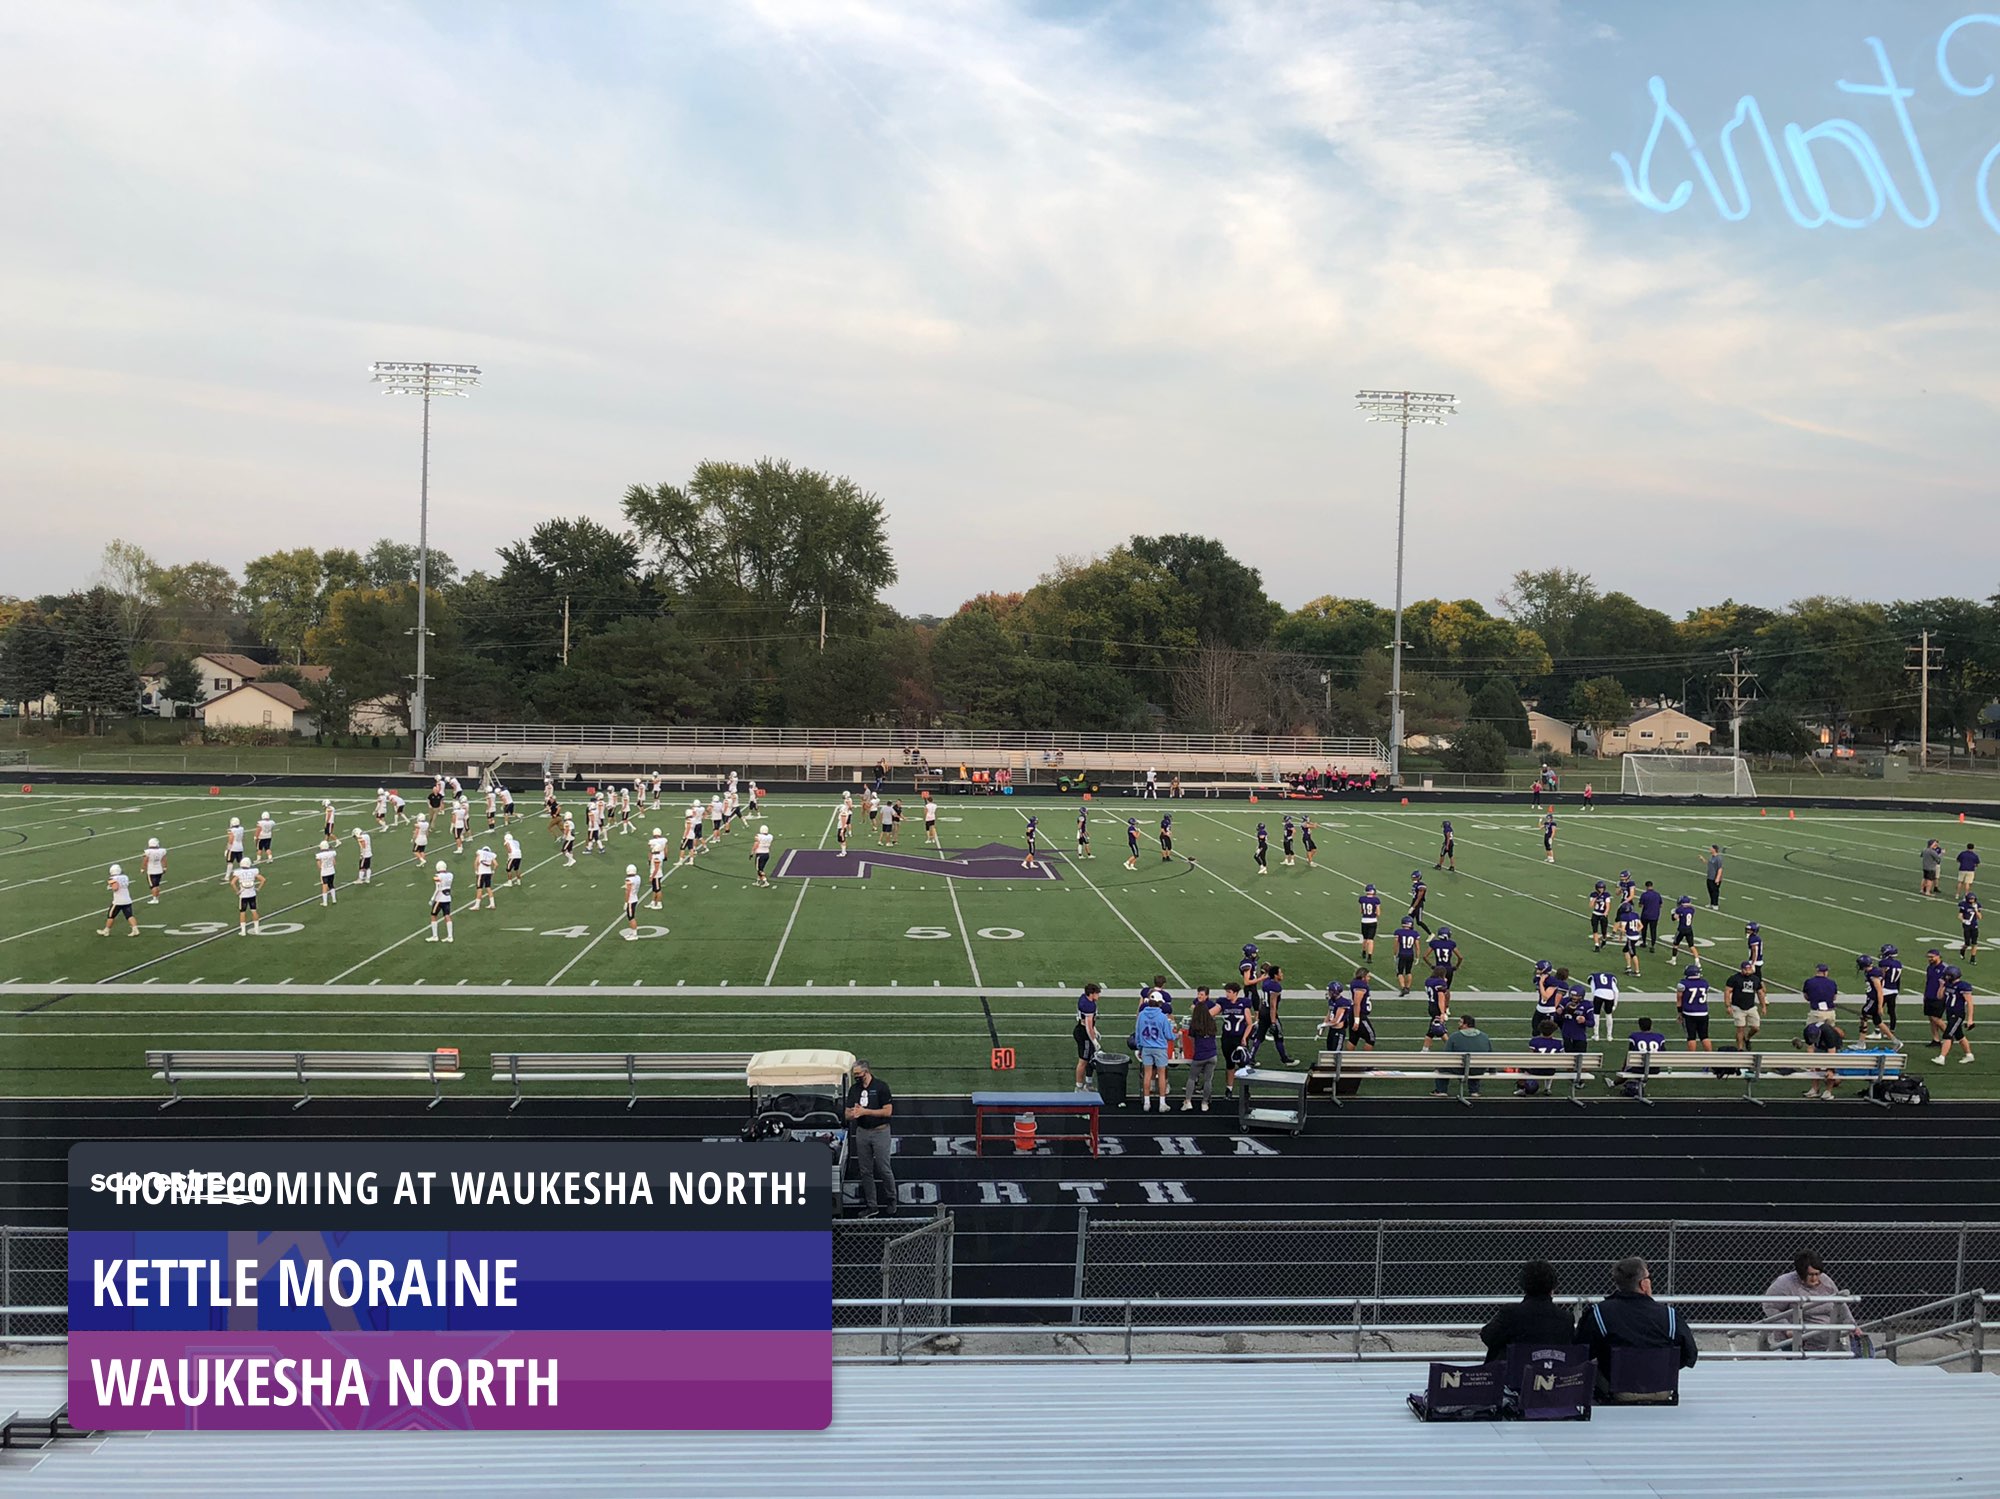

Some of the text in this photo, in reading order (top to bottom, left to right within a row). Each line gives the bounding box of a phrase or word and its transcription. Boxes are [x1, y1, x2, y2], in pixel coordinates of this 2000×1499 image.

[903, 925, 1025, 940] 50
[1401, 935, 1415, 950] 10
[1436, 948, 1450, 963] 13
[1599, 973, 1608, 985] 6
[1688, 987, 1707, 1004] 73
[1223, 1014, 1244, 1032] 57
[994, 1049, 1014, 1069] 50
